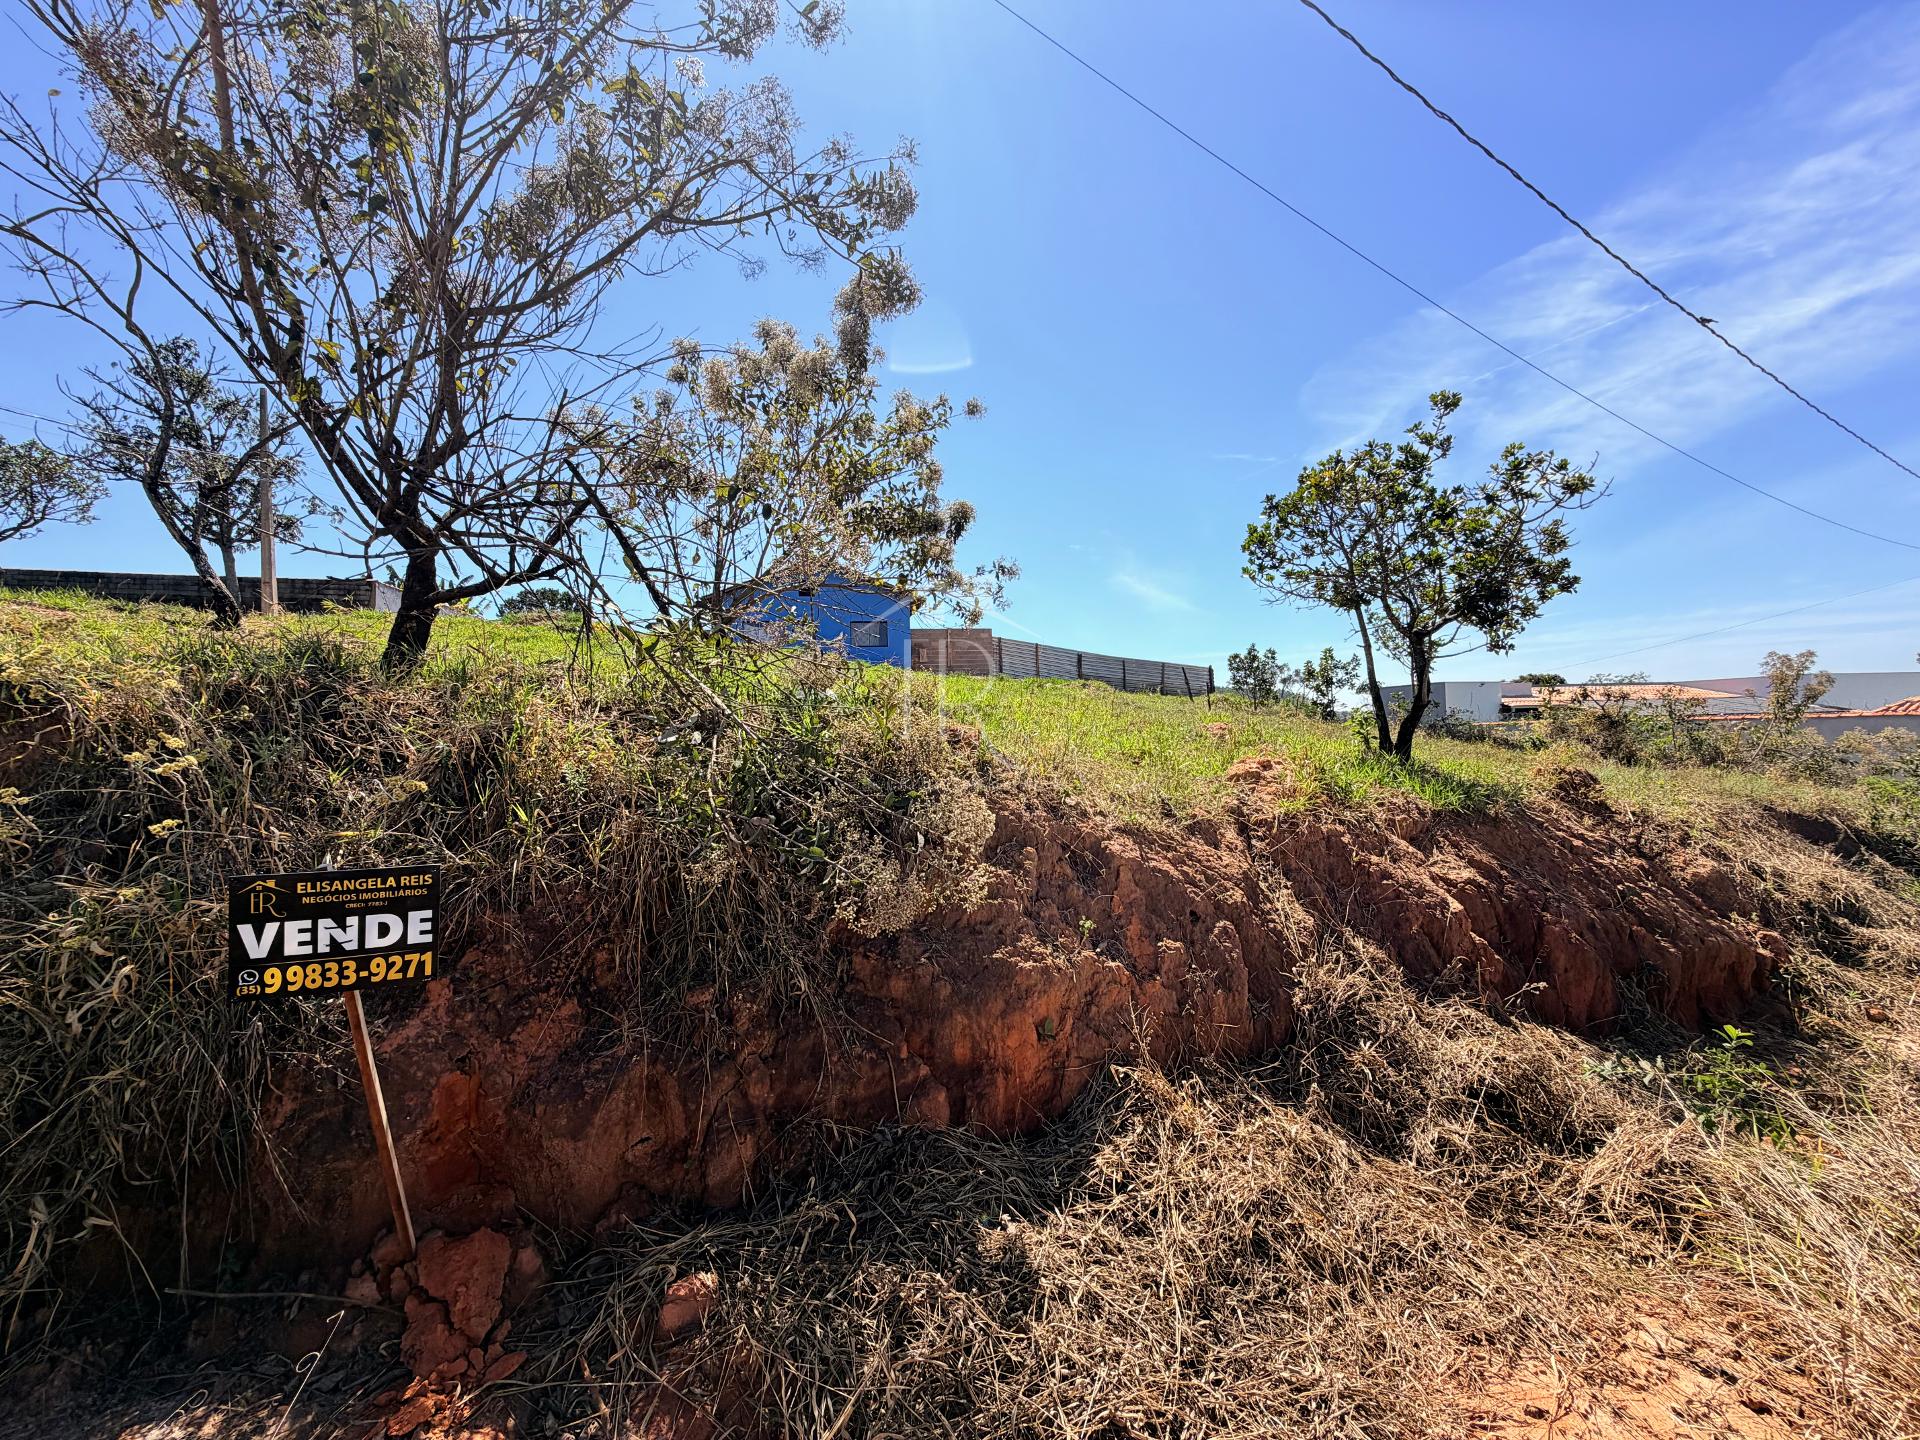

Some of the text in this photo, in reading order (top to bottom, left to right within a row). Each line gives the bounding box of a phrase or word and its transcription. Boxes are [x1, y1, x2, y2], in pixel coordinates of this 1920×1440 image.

[297, 874, 432, 894] ELISANGELA REIS
[302, 888, 428, 904] NEGÓCIOS IMOBILIÁRIOS
[236, 910, 433, 959] VENDE
[236, 986, 261, 996] (35)
